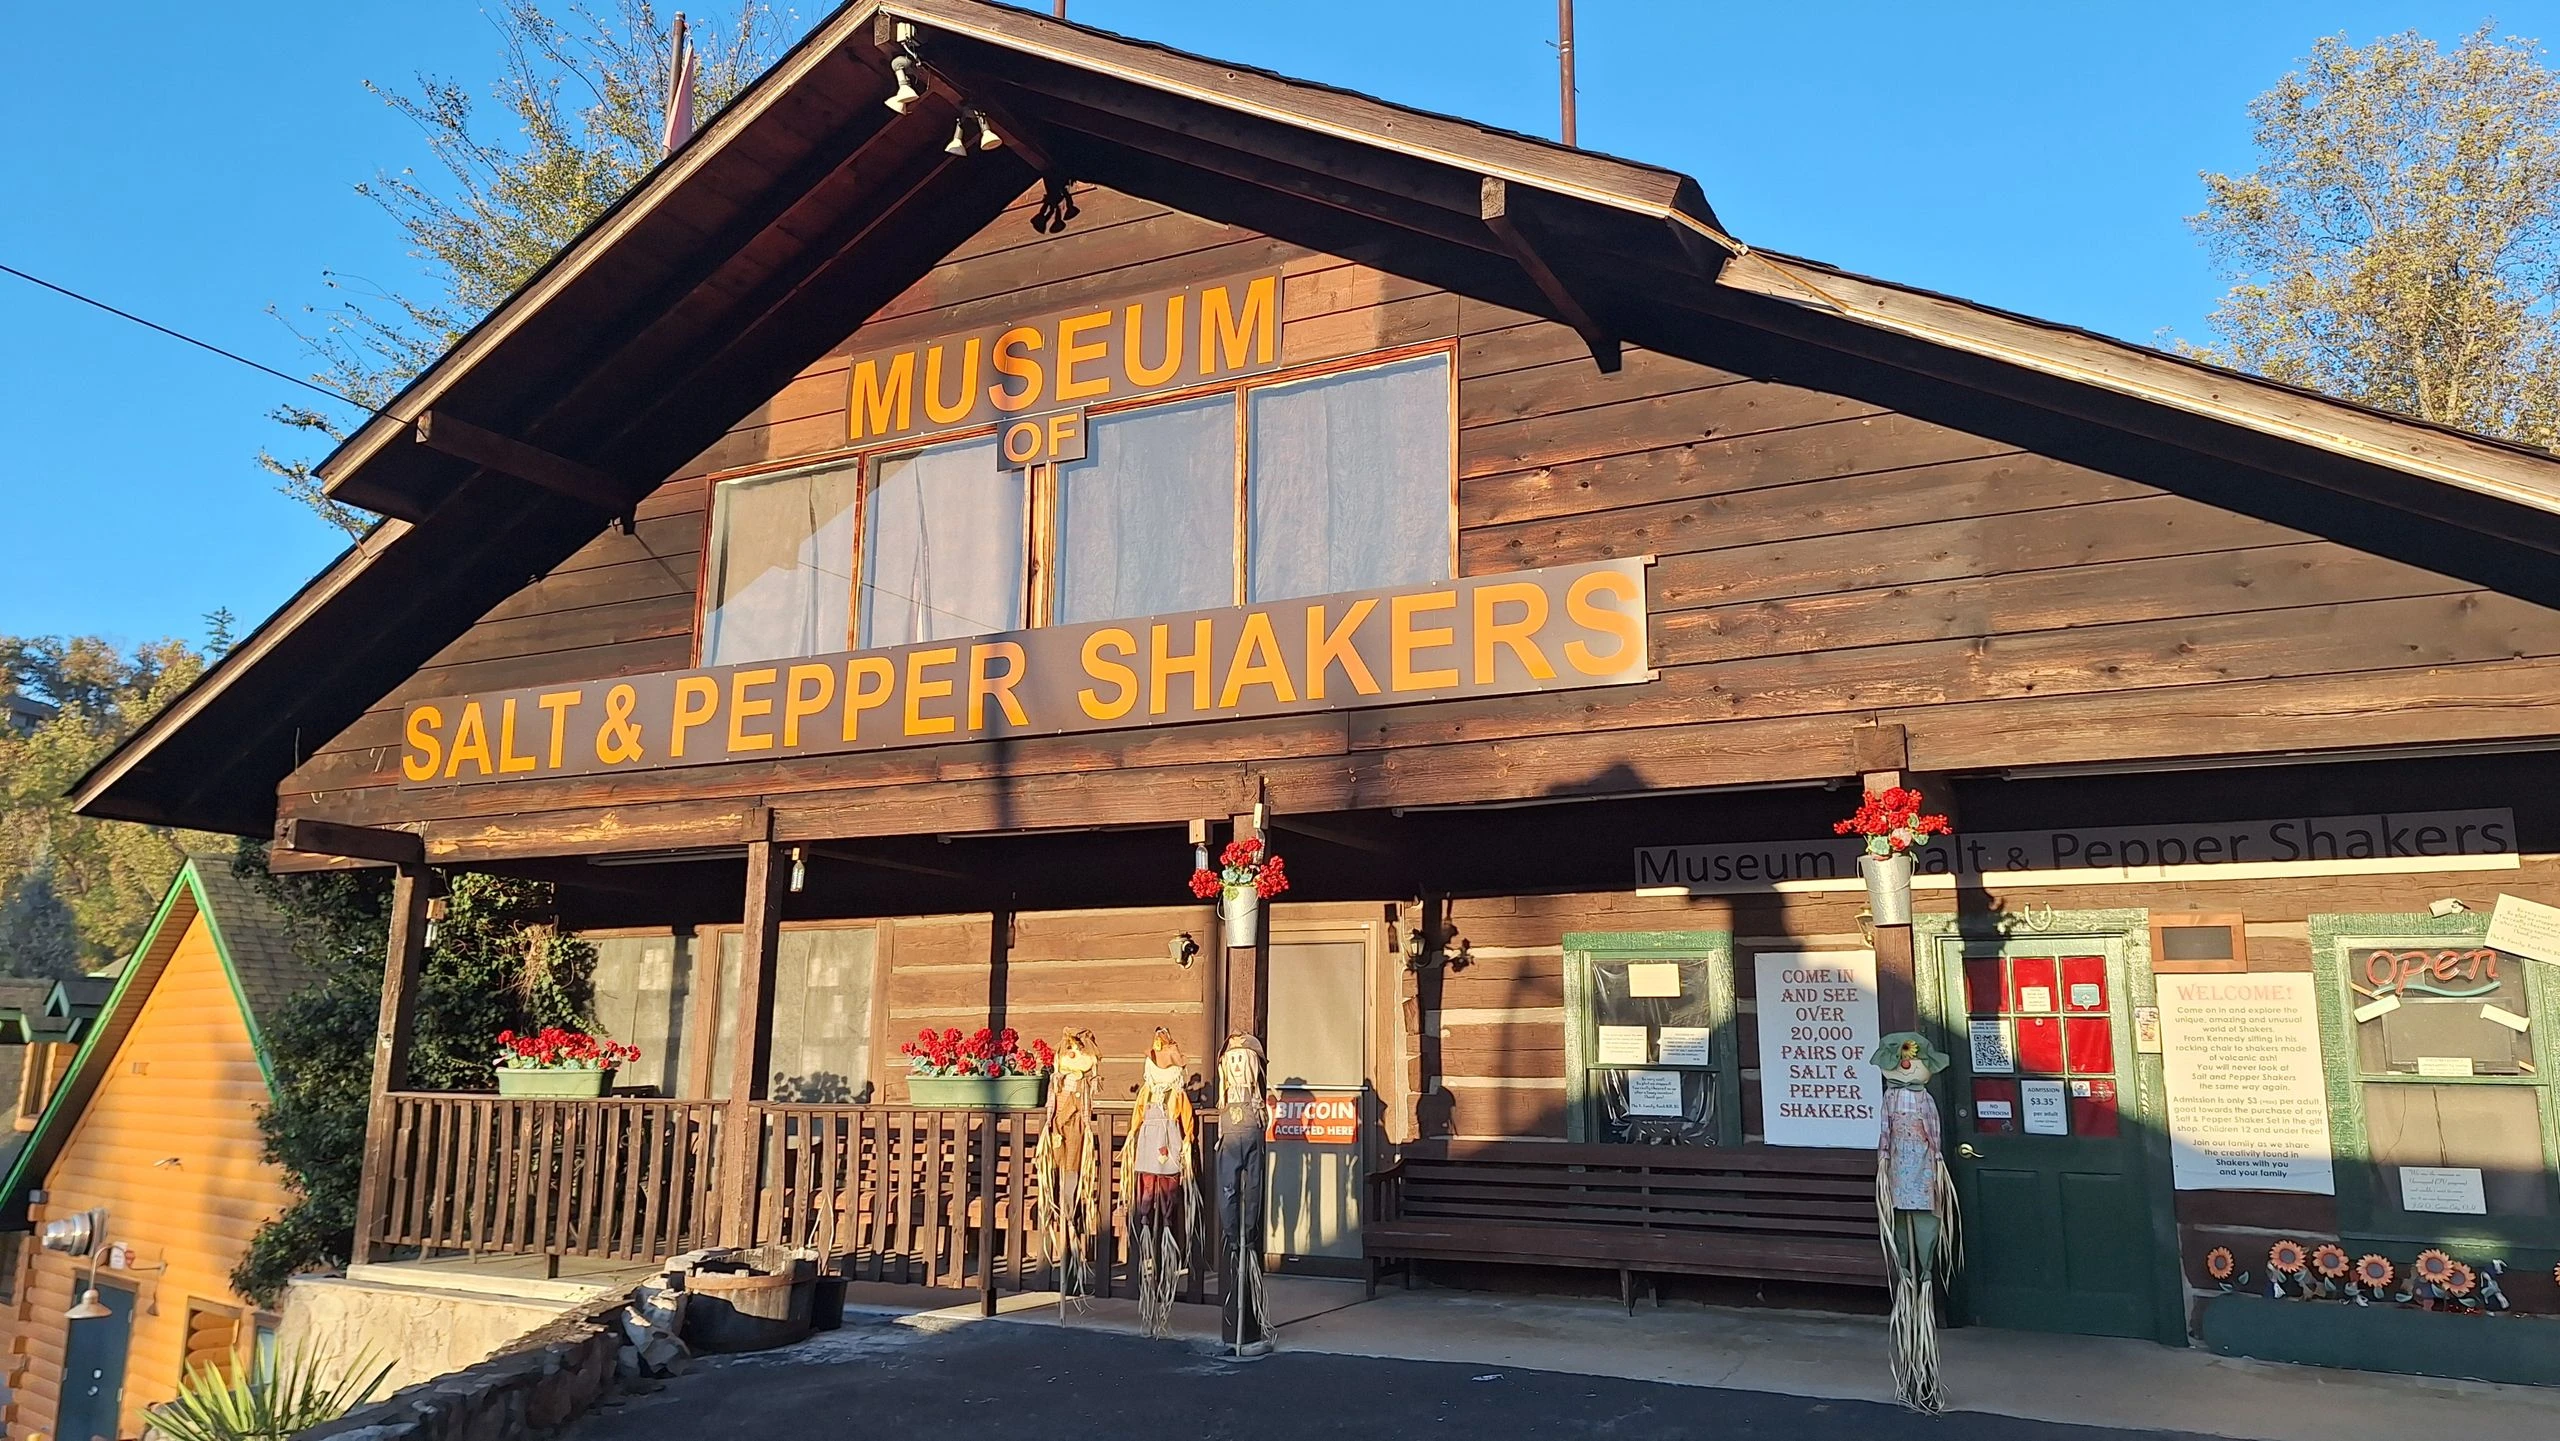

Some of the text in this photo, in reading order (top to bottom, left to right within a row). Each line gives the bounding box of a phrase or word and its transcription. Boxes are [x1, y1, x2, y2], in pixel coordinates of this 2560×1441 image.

[850, 276, 1276, 440] MUSEUM
[1003, 413, 1079, 462] OF
[402, 571, 1641, 782] SALT & PEPPER SHAKERS
[1640, 815, 2509, 885] Museum alt & Pepper Shakers
[1782, 969, 1854, 984] COME IN
[2366, 949, 2500, 996] Open
[1781, 988, 1858, 1003] AND SEE
[2176, 983, 2294, 1001] WELCOME!
[1796, 1005, 1846, 1022] OVER
[2177, 1006, 2203, 1014] Come
[2218, 1006, 2226, 1014] in
[2229, 1006, 2246, 1014] and
[2248, 1006, 2281, 1015] explore
[2284, 1006, 2298, 1014] the
[2175, 1016, 2302, 1025] unique, amazing and unusual
[1791, 1026, 1853, 1042] 20,000
[2239, 1025, 2274, 1033] Shakers.
[2207, 1035, 2245, 1044] Kennedy
[2247, 1035, 2272, 1044] sitting
[2285, 1035, 2297, 1043] his
[1781, 1045, 1865, 1061] PAIRS OF
[2175, 1044, 2208, 1053] rocking
[2210, 1044, 2232, 1052] chair
[2281, 1045, 2307, 1053] made
[2259, 1054, 2277, 1062] ash!
[1789, 1065, 1858, 1079] SALT &
[2229, 1074, 2260, 1082] Pepper
[2262, 1074, 2296, 1082] Shakers
[1790, 1084, 1862, 1100] PEPPER
[2242, 1084, 2259, 1092] way
[2262, 1084, 2290, 1092] again.
[2227, 1096, 2245, 1105] only
[2247, 1096, 2257, 1105] $3
[2280, 1099, 2293, 1107] per
[1275, 1101, 1354, 1120] BITCOIN
[1780, 1103, 1874, 1120] SHAKERS!
[2174, 1106, 2196, 1114] good
[2199, 1106, 2232, 1114] towards
[2235, 1106, 2248, 1114] the
[2251, 1107, 2292, 1115] purchase
[2306, 1108, 2322, 1116] any
[2176, 1115, 2190, 1123] Salt
[2201, 1116, 2231, 1124] Pepper
[2234, 1116, 2264, 1124] Shaker
[2266, 1116, 2280, 1124] Set
[2282, 1116, 2290, 1124] in
[2309, 1117, 2322, 1126] gift
[1275, 1125, 1354, 1136] ACCEPTED HERE
[2177, 1125, 2199, 1133] shop.
[2202, 1125, 2238, 1133] Children
[2242, 1125, 2251, 1133] 12
[2253, 1126, 2270, 1134] and
[2273, 1126, 2298, 1134] under
[2192, 1139, 2210, 1147] Join
[2228, 1139, 2254, 1148] family
[2285, 1141, 2310, 1149] share
[2221, 1149, 2260, 1158] creativity
[2263, 1150, 2288, 1158] found
[2216, 1158, 2289, 1169] Shakers with you
[2239, 1170, 2258, 1178] your
[2260, 1169, 2287, 1178] family
